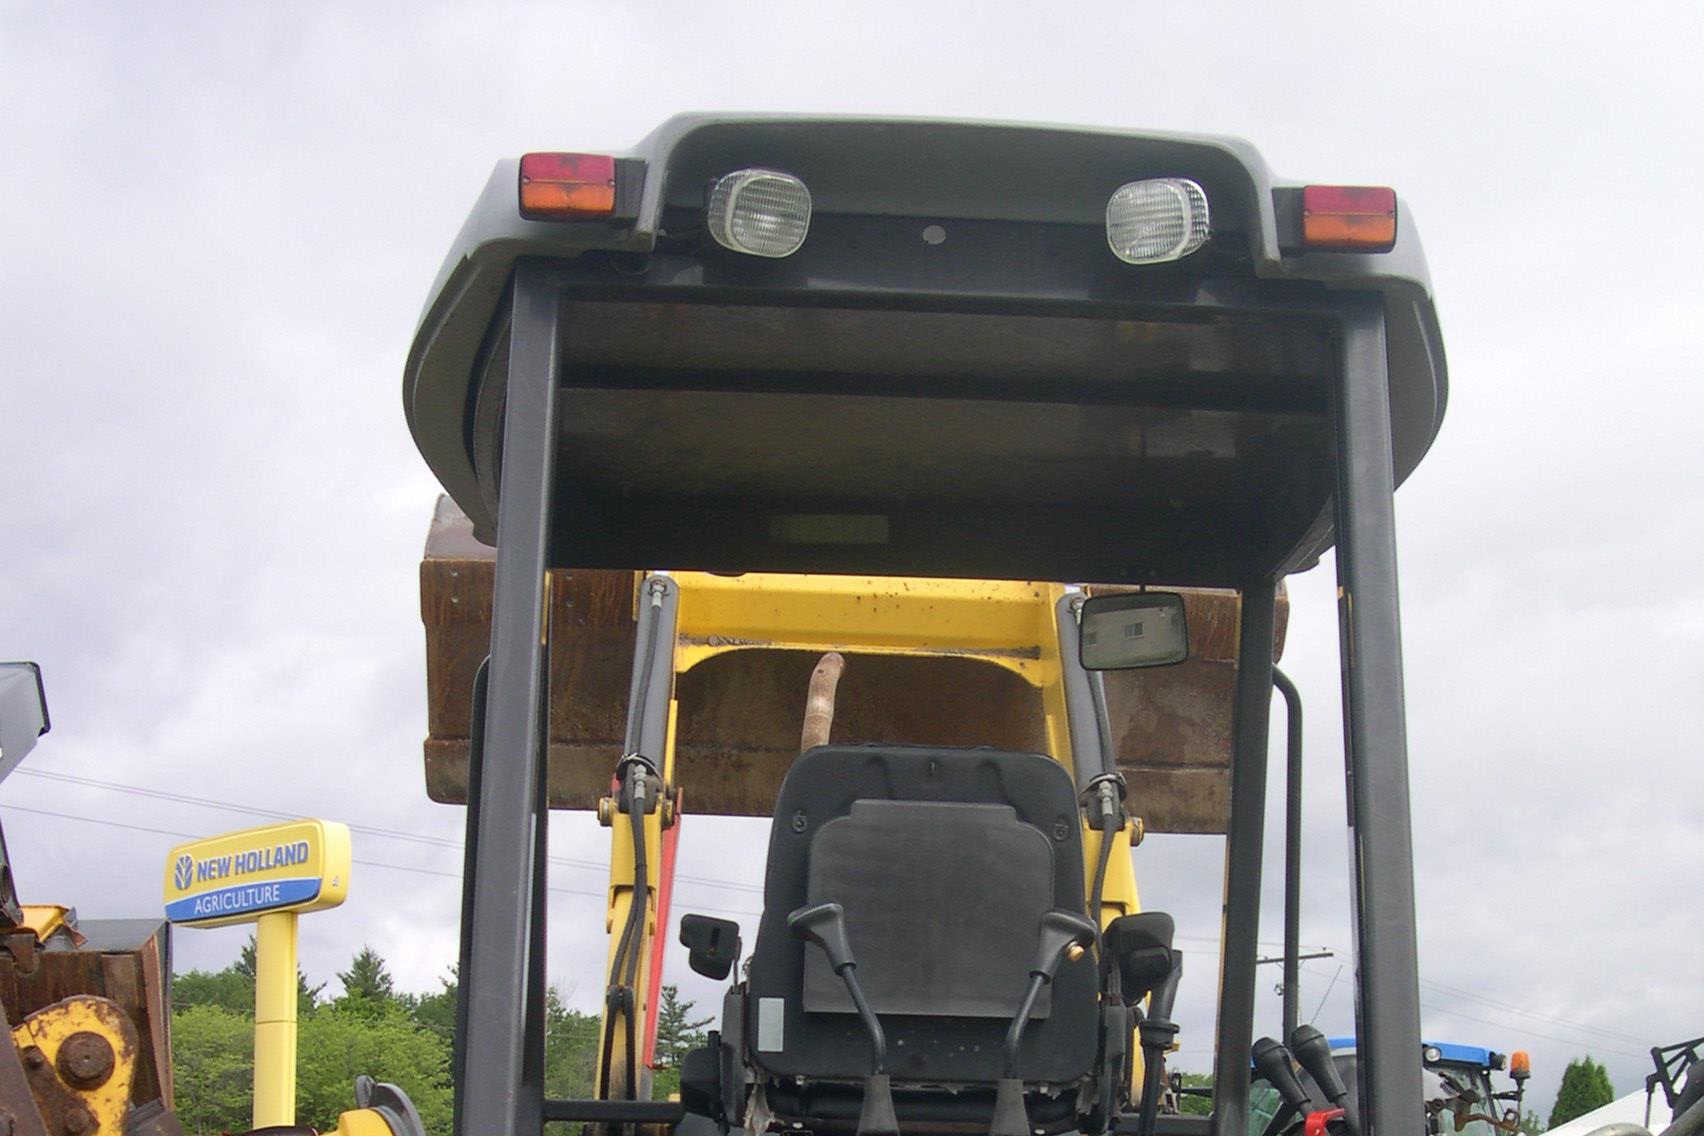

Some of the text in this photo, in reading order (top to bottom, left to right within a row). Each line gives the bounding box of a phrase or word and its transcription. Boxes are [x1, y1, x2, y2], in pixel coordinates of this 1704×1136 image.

[197, 842, 309, 882] NEW HOLLAND
[194, 884, 280, 915] AGRICULTURE
